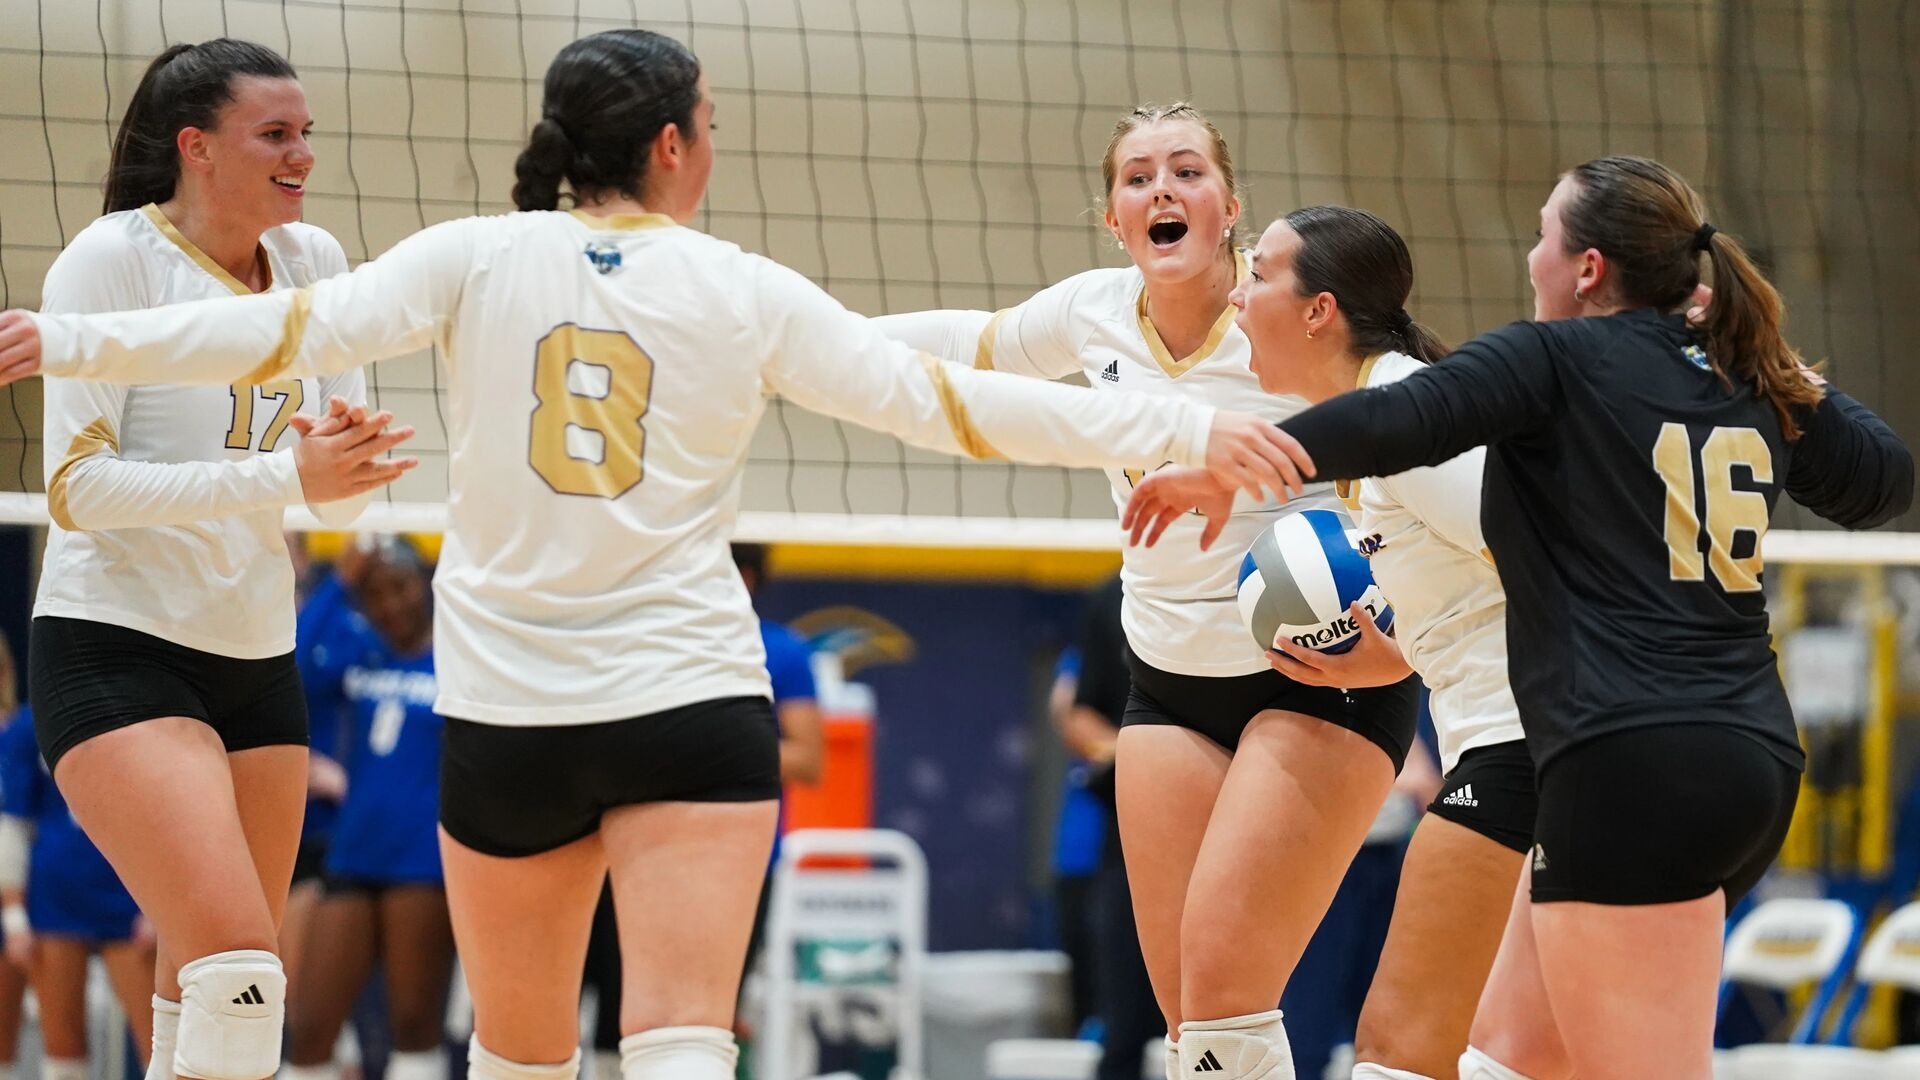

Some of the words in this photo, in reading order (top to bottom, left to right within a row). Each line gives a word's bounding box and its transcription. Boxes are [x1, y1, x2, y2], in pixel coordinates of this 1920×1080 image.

[224, 379, 304, 452] 17
[529, 322, 653, 499] 8
[1652, 421, 1774, 593] 16
[1443, 796, 1479, 807] adidas
